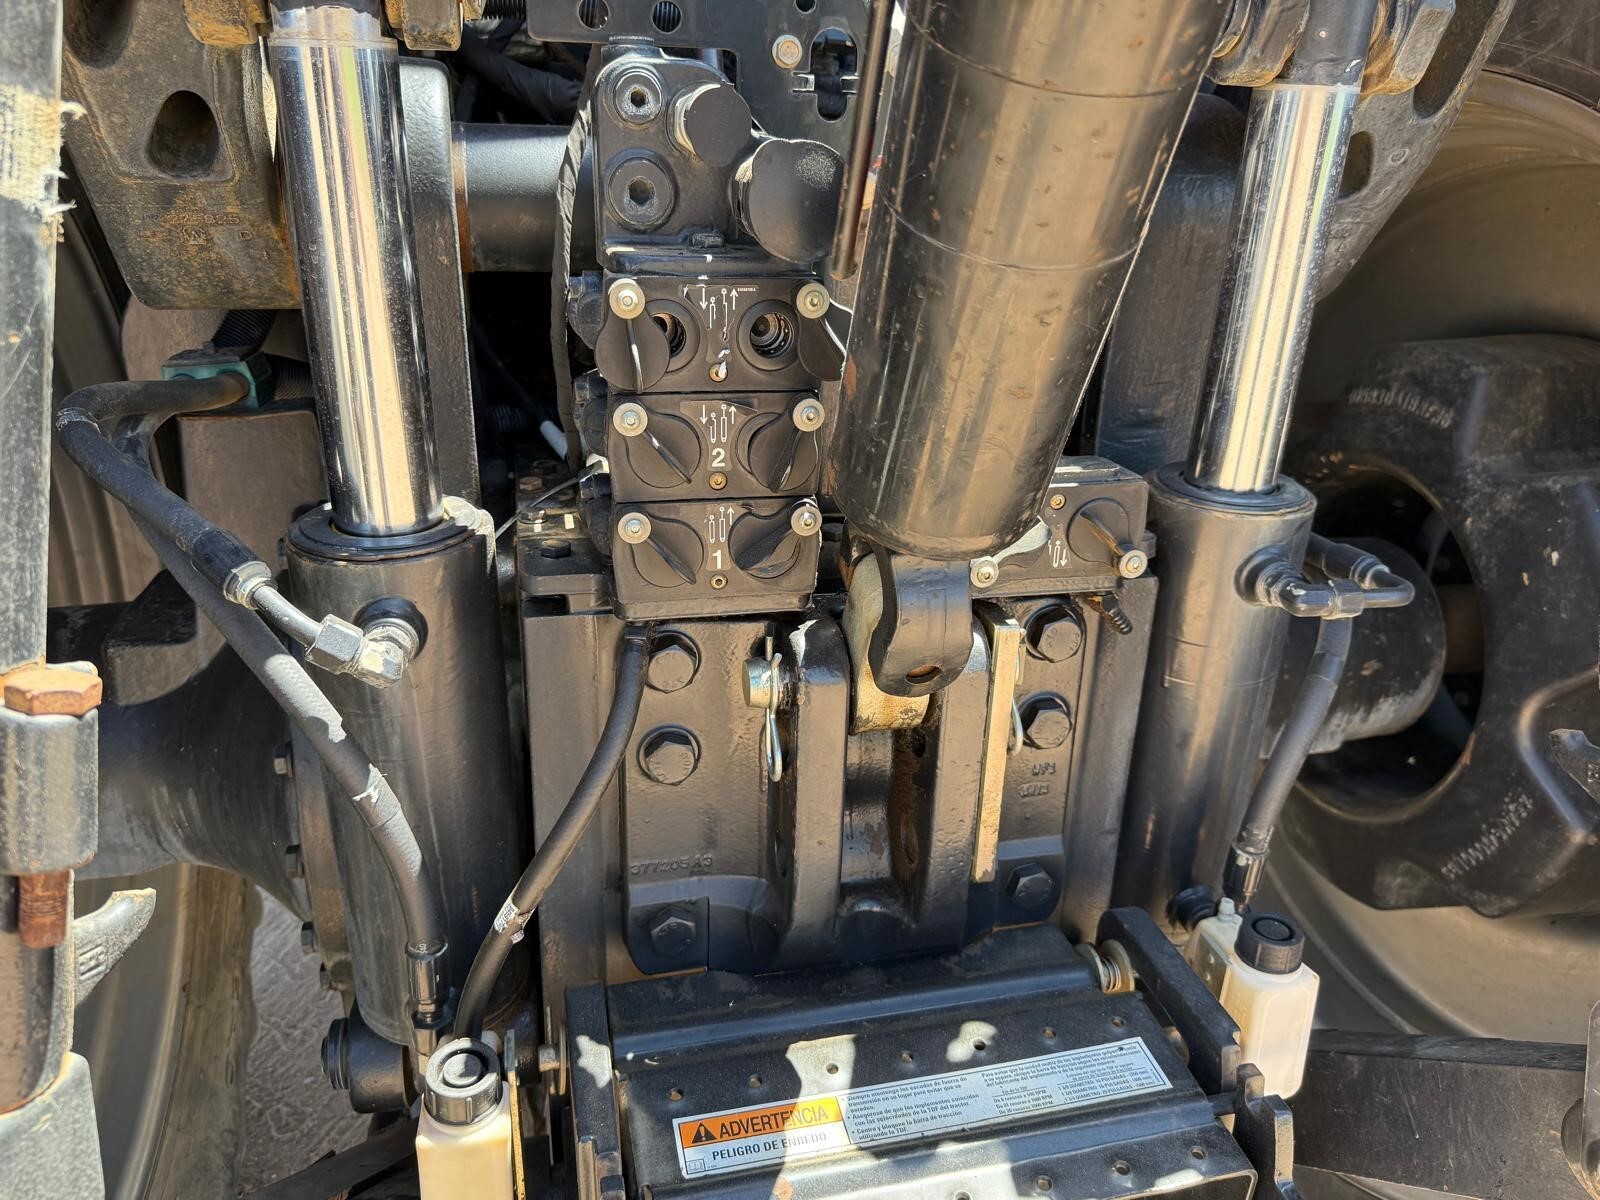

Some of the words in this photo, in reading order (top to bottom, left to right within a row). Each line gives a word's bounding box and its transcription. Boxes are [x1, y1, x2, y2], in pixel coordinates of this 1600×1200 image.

[711, 447, 726, 467] 2
[712, 549, 724, 569] 1
[846, 1093, 871, 1102] Siempre
[871, 1088, 899, 1098] mantenga
[914, 1098, 950, 1109] implementos
[719, 1105, 830, 1139] ADVERTENCIA
[712, 1143, 761, 1161] PELIGRO
[764, 1140, 779, 1152] DE
[782, 1131, 828, 1149] ENREDO
